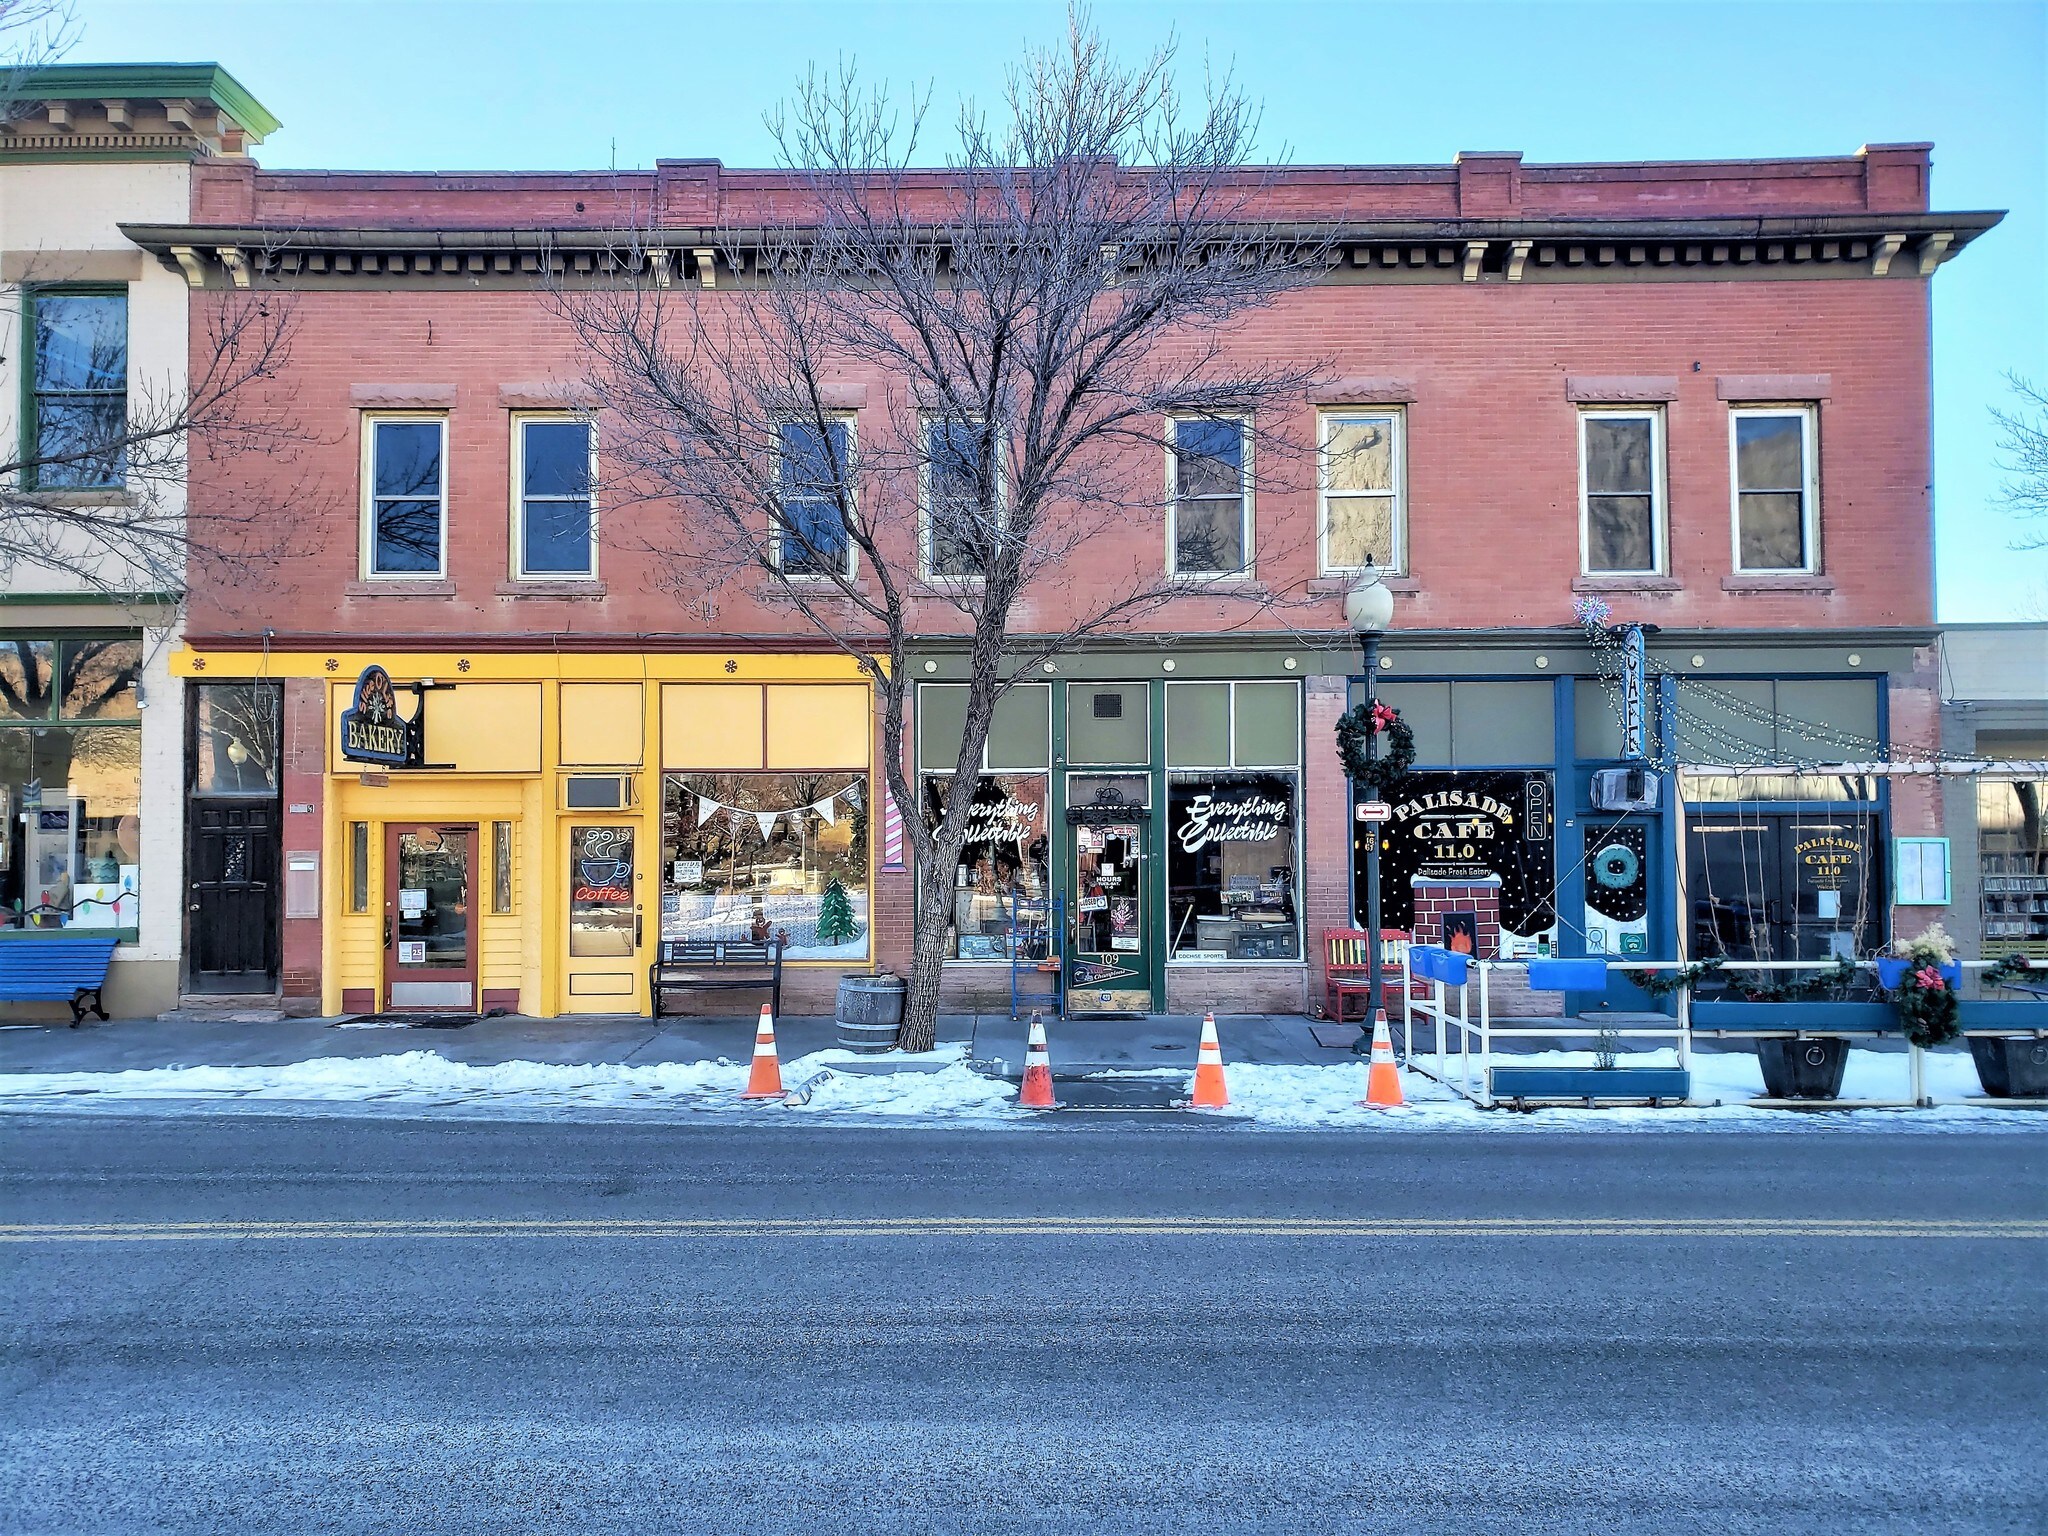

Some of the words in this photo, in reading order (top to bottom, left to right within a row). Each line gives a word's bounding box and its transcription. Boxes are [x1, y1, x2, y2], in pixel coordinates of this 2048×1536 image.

[348, 720, 404, 755] BAKERY
[941, 798, 1039, 825] verything
[1185, 795, 1287, 825] Everything
[1392, 790, 1513, 823] PALISADE
[1529, 783, 1543, 838] OPEN
[932, 824, 1031, 843] llectible
[1177, 821, 1279, 854] Collectible
[1413, 821, 1496, 840] CAFE
[1433, 843, 1475, 860] 11.0
[1794, 836, 1863, 855] PALISADE
[1804, 854, 1852, 865] CAFE
[1417, 868, 1447, 876] Palisade
[1448, 868, 1468, 876] Fresh
[1469, 868, 1493, 877] Eatery
[575, 886, 630, 901] Coffee
[1100, 953, 1119, 965] 109
